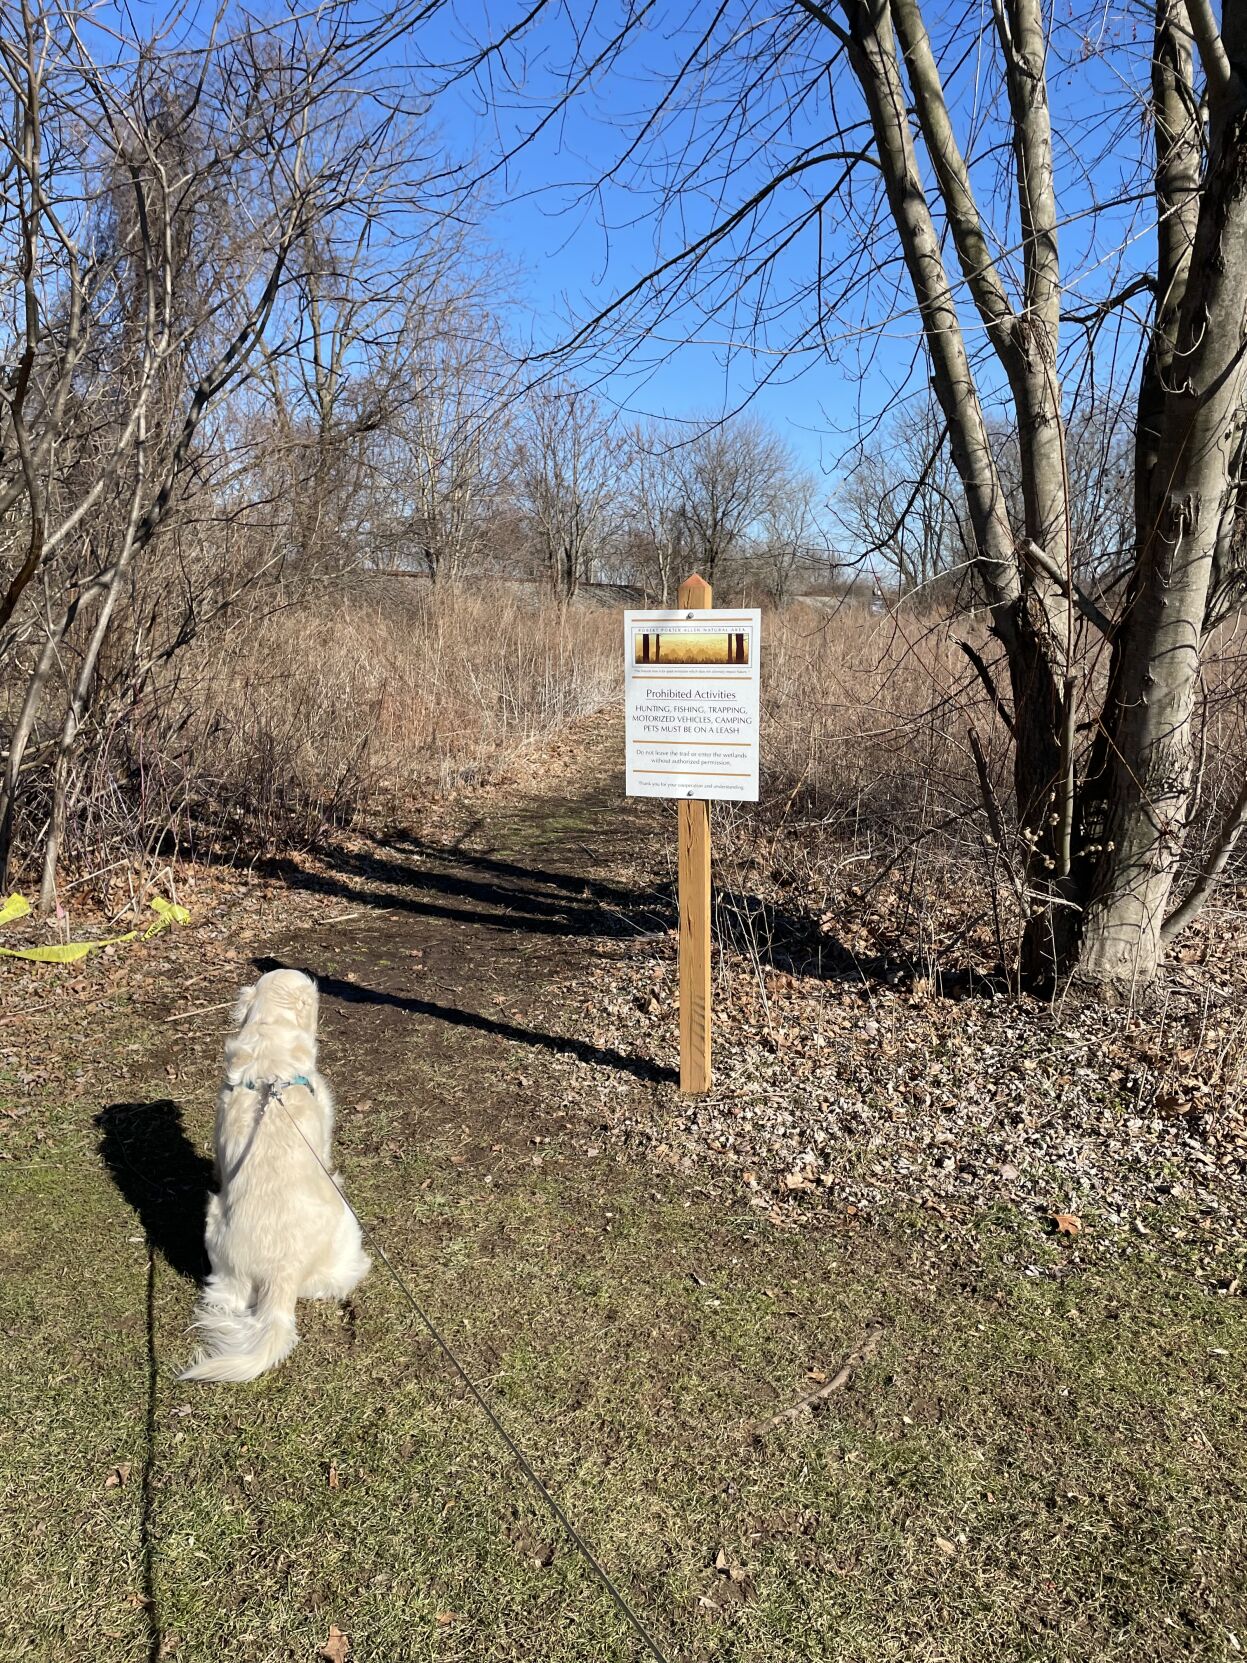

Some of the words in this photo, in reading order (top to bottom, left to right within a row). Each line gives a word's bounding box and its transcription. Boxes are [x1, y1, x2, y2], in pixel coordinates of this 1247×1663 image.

[646, 689, 692, 698] Prohibited
[694, 690, 736, 699] Activities
[635, 705, 672, 713] HUNTING,
[674, 706, 706, 714] FISHING,
[708, 706, 748, 714] TRAPPING,
[677, 716, 713, 724] VEHICLES,
